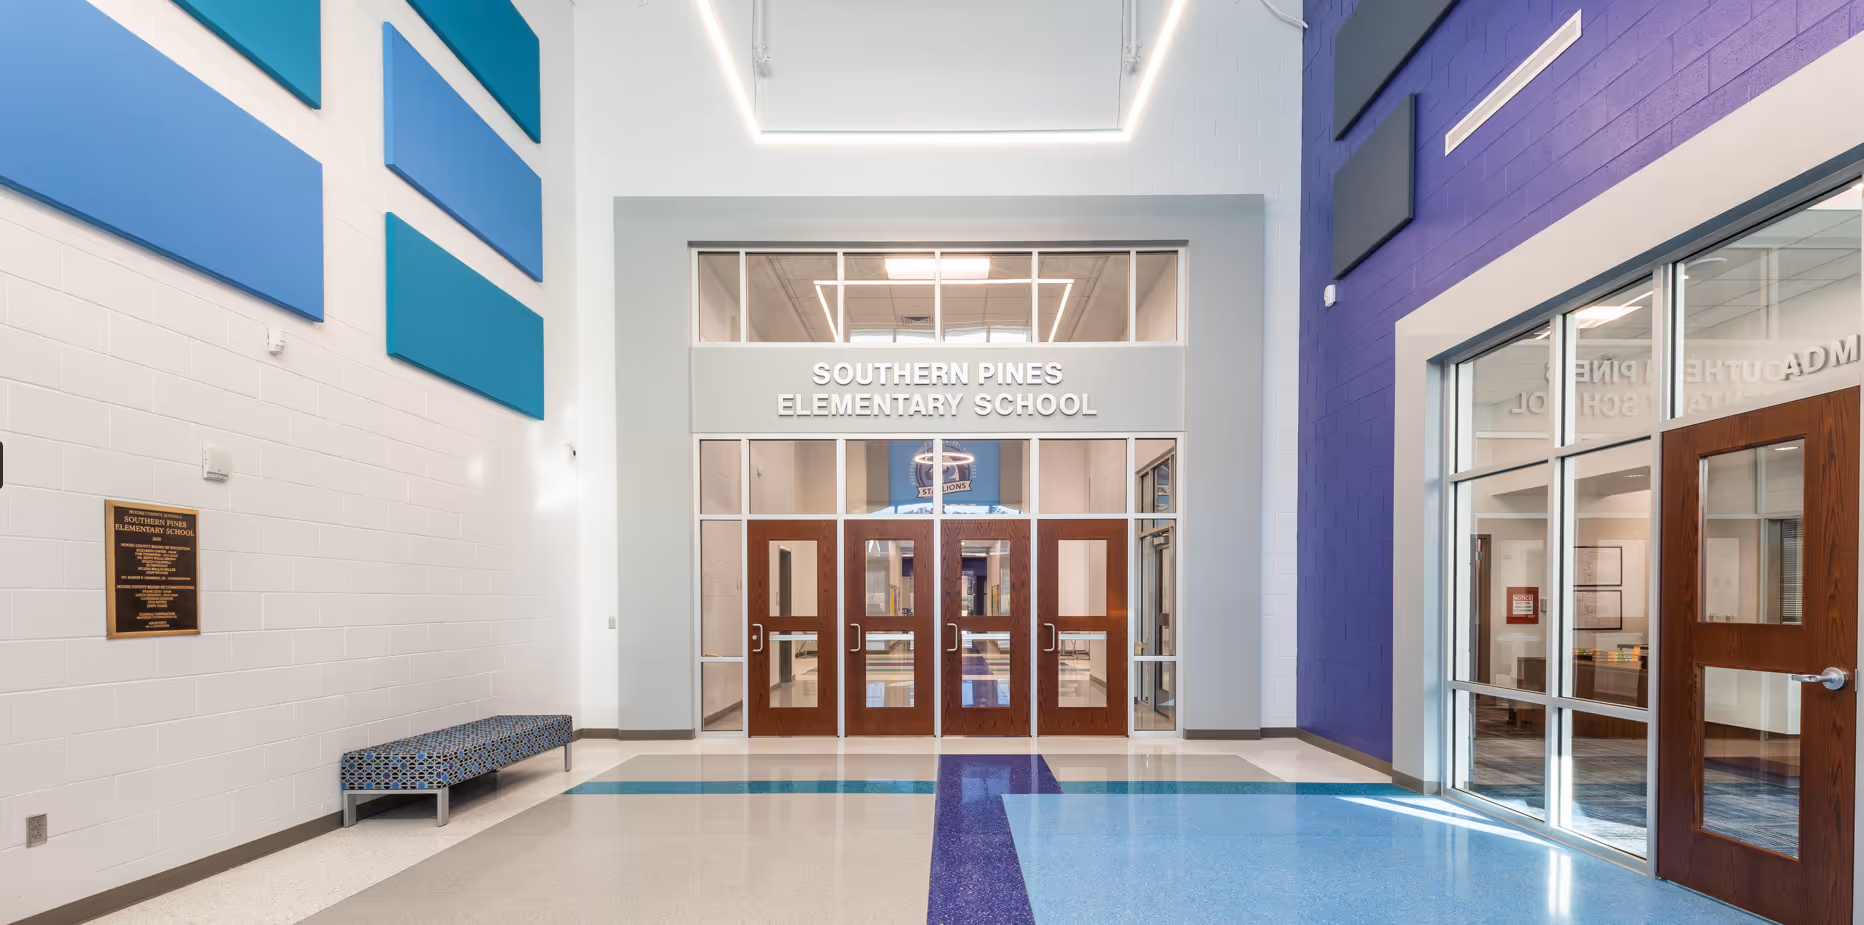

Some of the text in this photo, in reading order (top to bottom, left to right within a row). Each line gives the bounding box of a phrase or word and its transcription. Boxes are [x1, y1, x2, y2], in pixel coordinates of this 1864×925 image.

[1779, 334, 1861, 381] ADM
[812, 362, 1064, 386] SOUTHERN PINES
[777, 393, 1098, 417] ELEMENTARY SCHOOL
[922, 482, 966, 496] STLIONS
[115, 524, 195, 536] ELEMENTARY SCHOOL
[124, 516, 187, 528] SOUTHERN PINES
